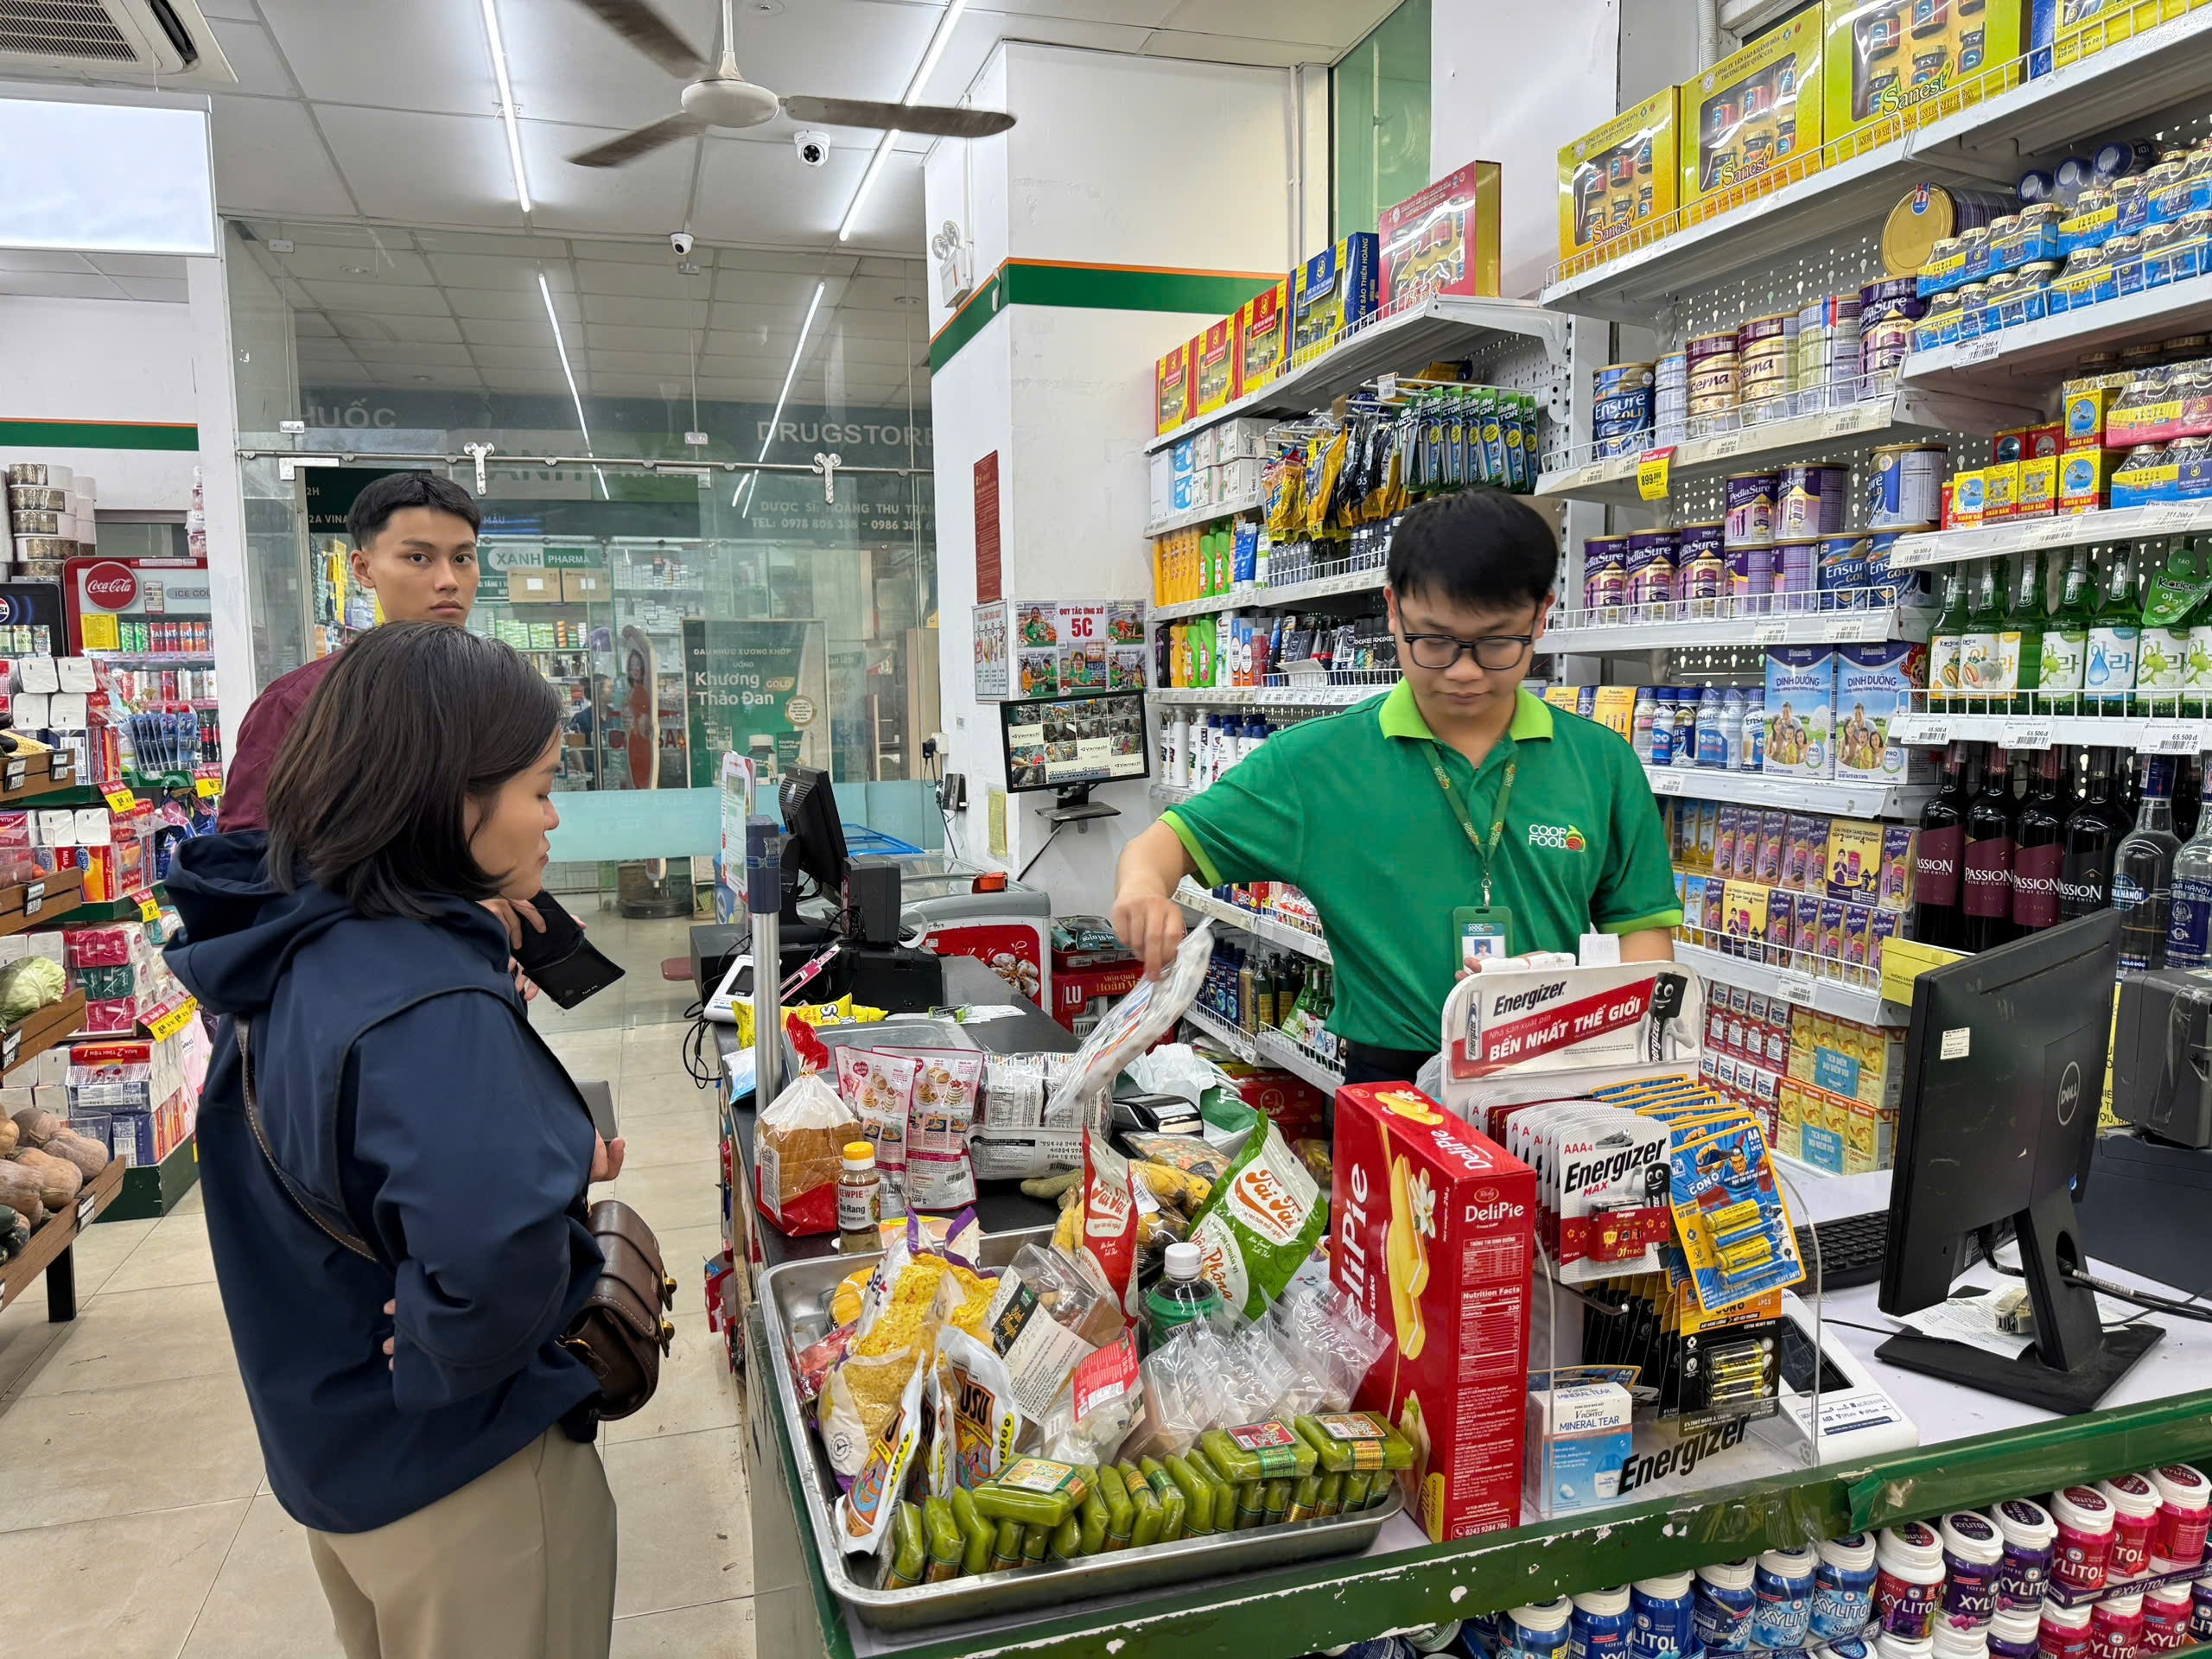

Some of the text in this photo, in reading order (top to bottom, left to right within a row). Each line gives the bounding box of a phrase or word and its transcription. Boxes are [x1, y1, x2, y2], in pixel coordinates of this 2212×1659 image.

[1882, 75, 1946, 117] Sanest
[1722, 155, 1769, 188] Sanest
[1593, 215, 1631, 244] Sanest
[1595, 392, 1646, 420] Ensure
[1613, 408, 1646, 423] GOLD
[1729, 484, 1770, 502] PediaSure
[876, 504, 899, 514] THU
[782, 519, 809, 529] 0978
[871, 520, 899, 530] 0986
[497, 553, 589, 565] XANH PHARMA
[1887, 568, 1916, 579] GOLD
[2158, 576, 2196, 594] Korice
[1071, 617, 1093, 637] 5C
[695, 671, 760, 688] Khương
[1777, 674, 1820, 687] DINH DƯỠNG
[1847, 674, 1897, 687] DINH DƯỠNG
[696, 690, 774, 706] Thảo Đan
[1529, 835, 1567, 849] FOOD
[1965, 867, 2013, 883] PASSION
[2014, 875, 2060, 892] PASSION
[1065, 985, 1082, 1005] LU
[1493, 981, 1566, 1017] Energizer
[1489, 1028, 1504, 1039] Nhà
[1539, 1014, 1552, 1026] pin
[1490, 996, 1641, 1062] BỀN NHẤT THẾ GIỚI
[1703, 1098, 1714, 1107] AA
[1747, 1128, 1760, 1141] AA
[1430, 1128, 1493, 1170] DeliPie
[1565, 1136, 1667, 1194] Energizer
[1245, 1168, 1282, 1202] Tài
[1583, 1180, 1608, 1197] MAX
[847, 1205, 865, 1214] Rang
[1465, 1202, 1524, 1223] DeliPie
[1463, 1287, 1520, 1300] Nutrition Facts
[1559, 1415, 1619, 1431] MINERAL TEAR
[1618, 1414, 1752, 1496] Energizer
[1465, 1522, 1508, 1536] 0243 9284 706
[1966, 1584, 1986, 1594] LOTTE
[2121, 1578, 2165, 1598] XYLITOL
[1879, 1590, 1939, 1614] XYLITOL
